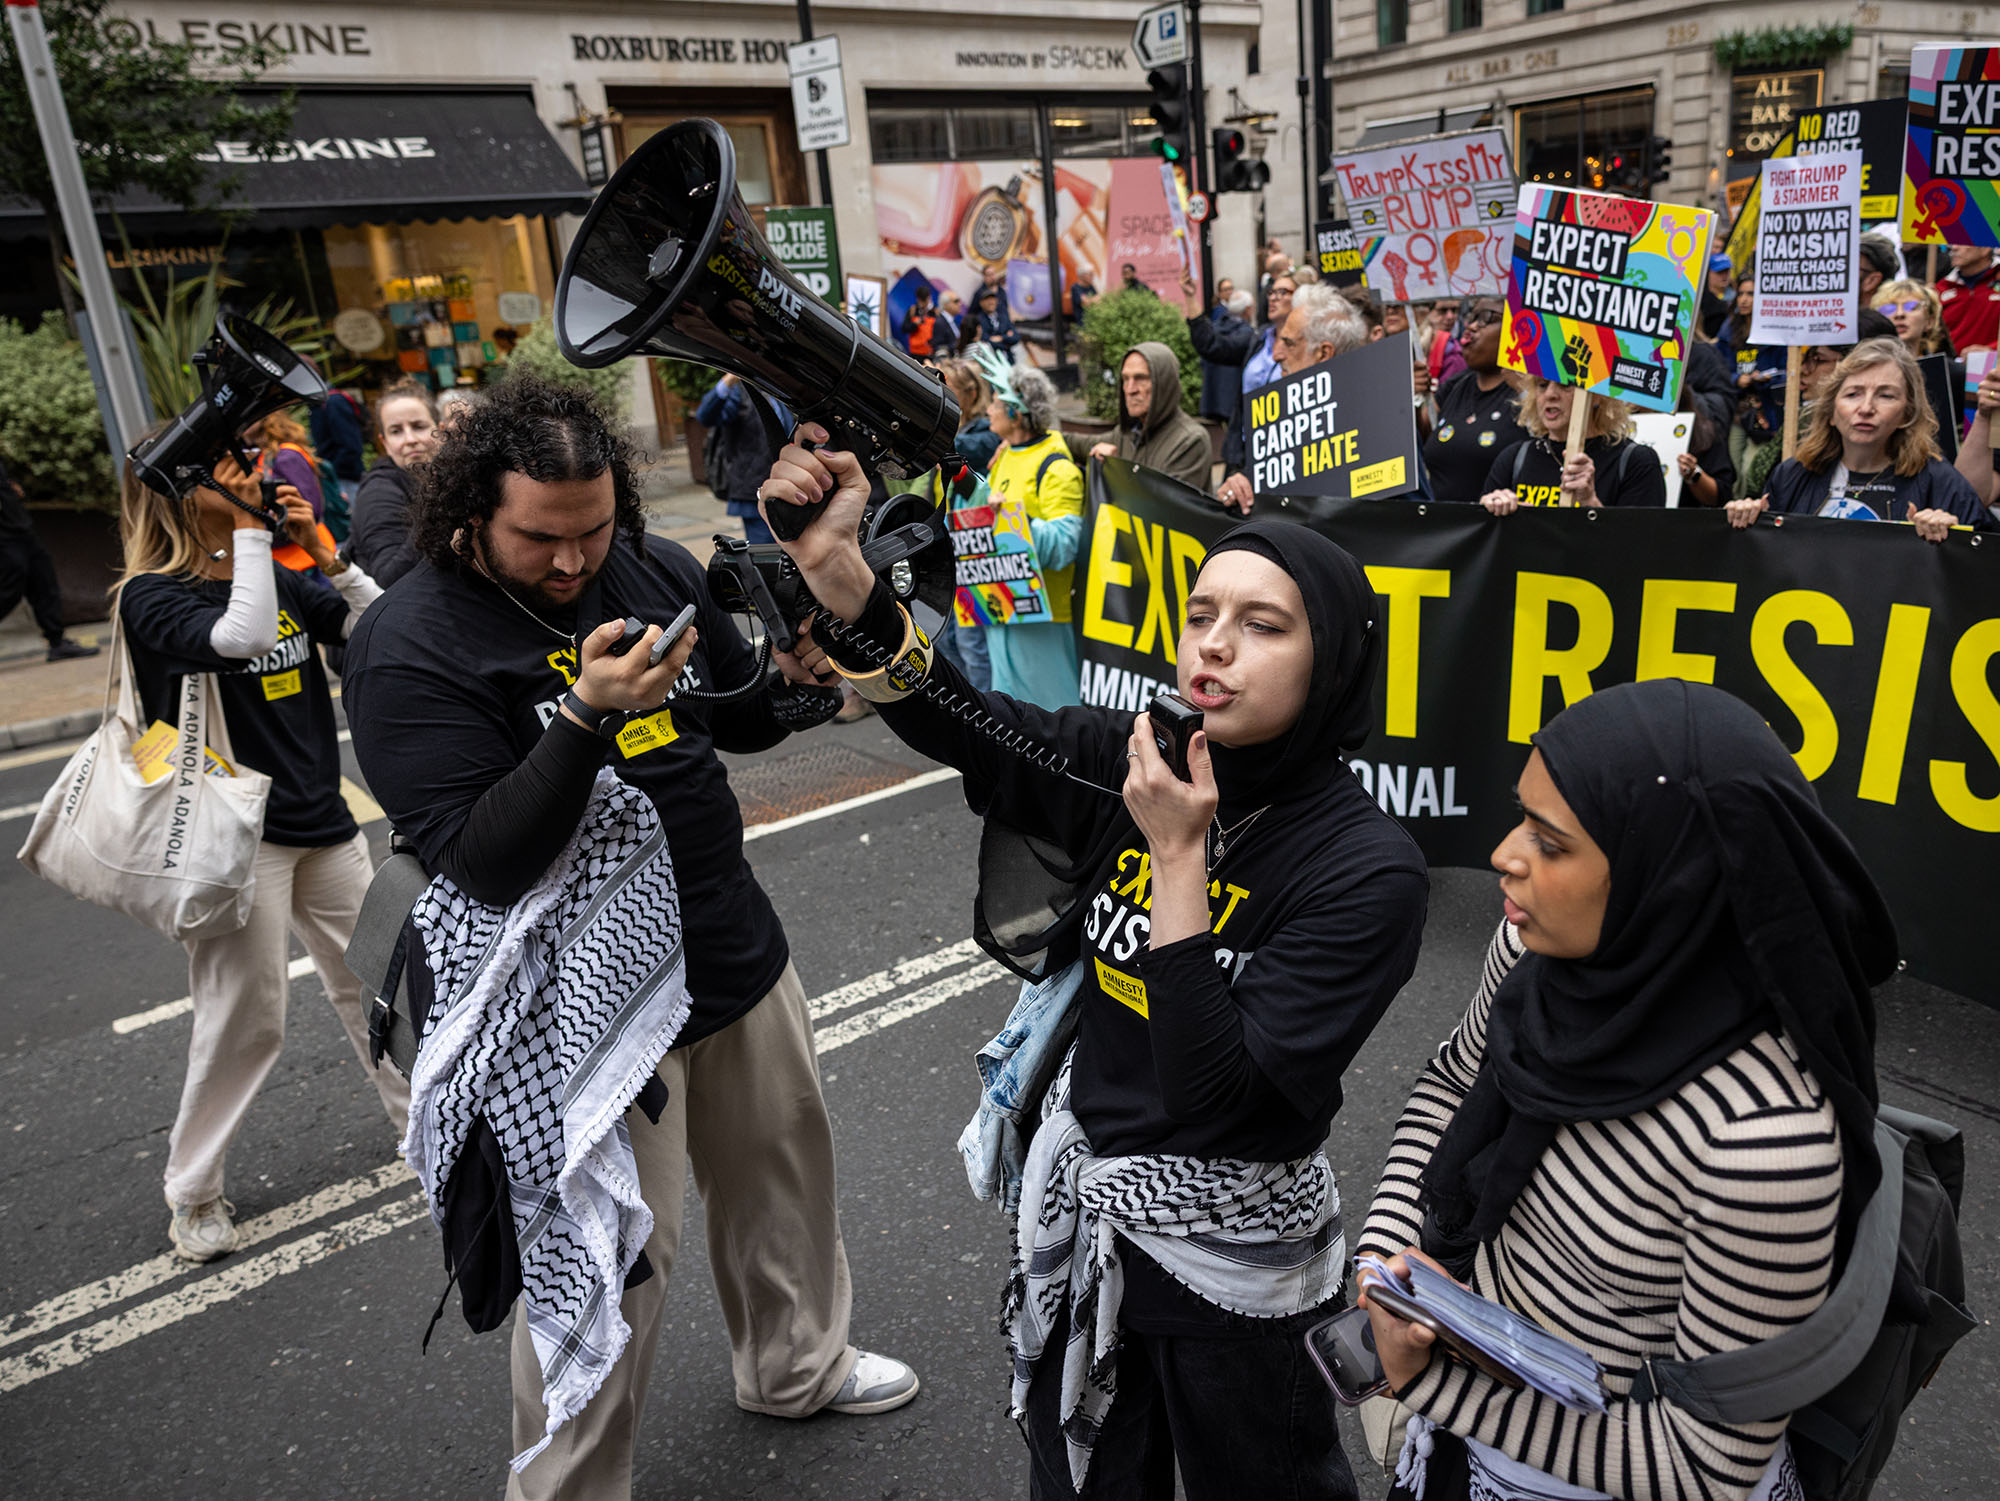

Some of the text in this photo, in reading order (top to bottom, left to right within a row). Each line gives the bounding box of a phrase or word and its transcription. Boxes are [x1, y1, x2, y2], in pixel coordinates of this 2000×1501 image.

[570, 34, 738, 63] ROXBURGHE
[955, 51, 1027, 67] INNOVATION
[1031, 53, 1045, 68] BY
[1446, 48, 1558, 82] ALL BAR ONE
[1754, 78, 1794, 98] ALL
[1751, 103, 1794, 124] BAR
[1798, 110, 1860, 141] NO RED
[1770, 164, 1847, 188] FIGHT TRUMP
[1773, 190, 1781, 206] &
[1782, 184, 1839, 206] STARMER
[1383, 186, 1473, 234] RUMP
[1764, 210, 1849, 233] NO TO WAR
[788, 220, 827, 241] THE
[1531, 221, 1627, 275] EXPECT
[1763, 231, 1848, 260] RACISM
[1762, 258, 1846, 274] CLIMATE CHAOS
[1762, 273, 1845, 293] CAPITALISM
[1524, 269, 1679, 338] RESISTANCE
[1775, 309, 1807, 318] STUDENTS
[1809, 309, 1814, 317] A
[1817, 308, 1845, 317] VOICE
[1801, 299, 1829, 307] PARTY
[1832, 298, 1843, 307] TO
[1615, 363, 1647, 380] AMNESTY
[214, 384, 234, 407] YLE
[1251, 371, 1332, 429] NO RED
[1252, 402, 1338, 461] CARPET
[1253, 429, 1360, 494] FOR HATE
[1357, 470, 1383, 483] AMNESTY
[908, 651, 926, 673] RESIST
[179, 711, 198, 787] ADANOLA
[163, 795, 189, 870] ADANOLA
[1103, 969, 1143, 997] AMNESTY
[1105, 979, 1144, 1007] INTERNATIONAL
